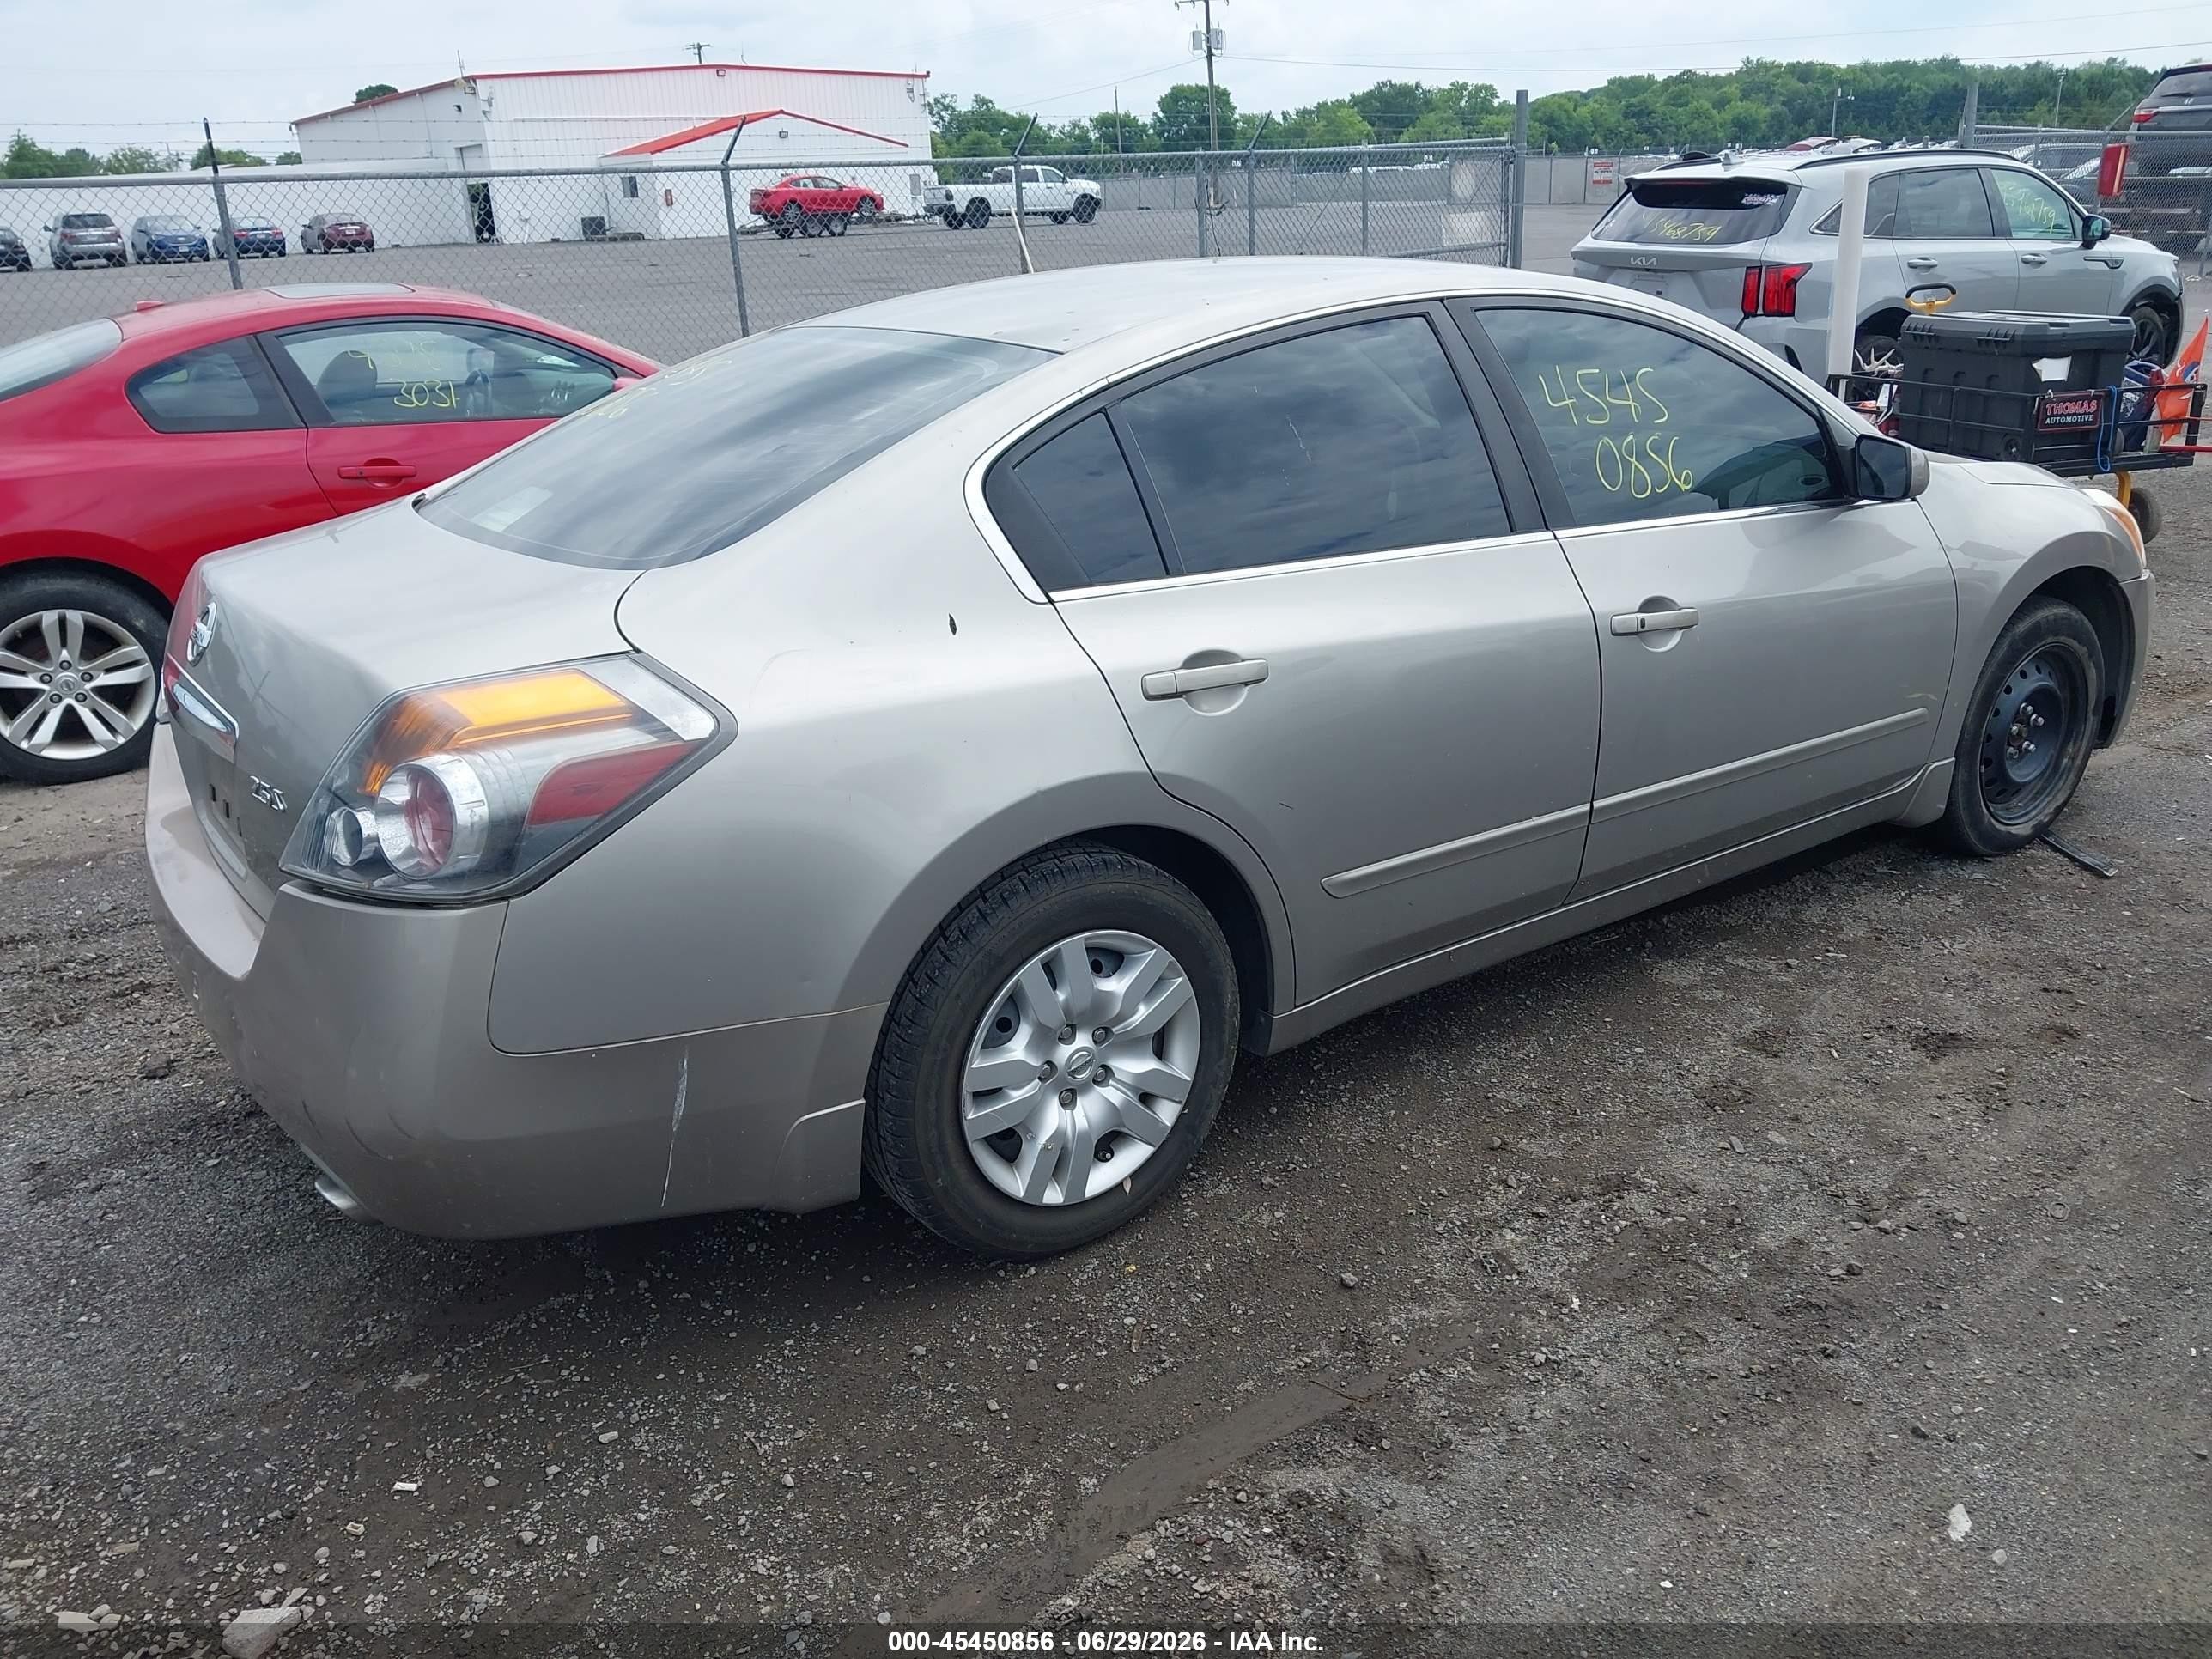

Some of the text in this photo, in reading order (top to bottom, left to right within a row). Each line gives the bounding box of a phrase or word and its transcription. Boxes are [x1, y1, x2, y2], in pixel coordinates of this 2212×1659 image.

[1630, 256, 1657, 266] KIA
[1538, 364, 1668, 426] 4545
[2045, 399, 2098, 416] THOMAS
[2045, 414, 2094, 424] AUTOMOTIVE
[1595, 432, 1693, 499] 0856
